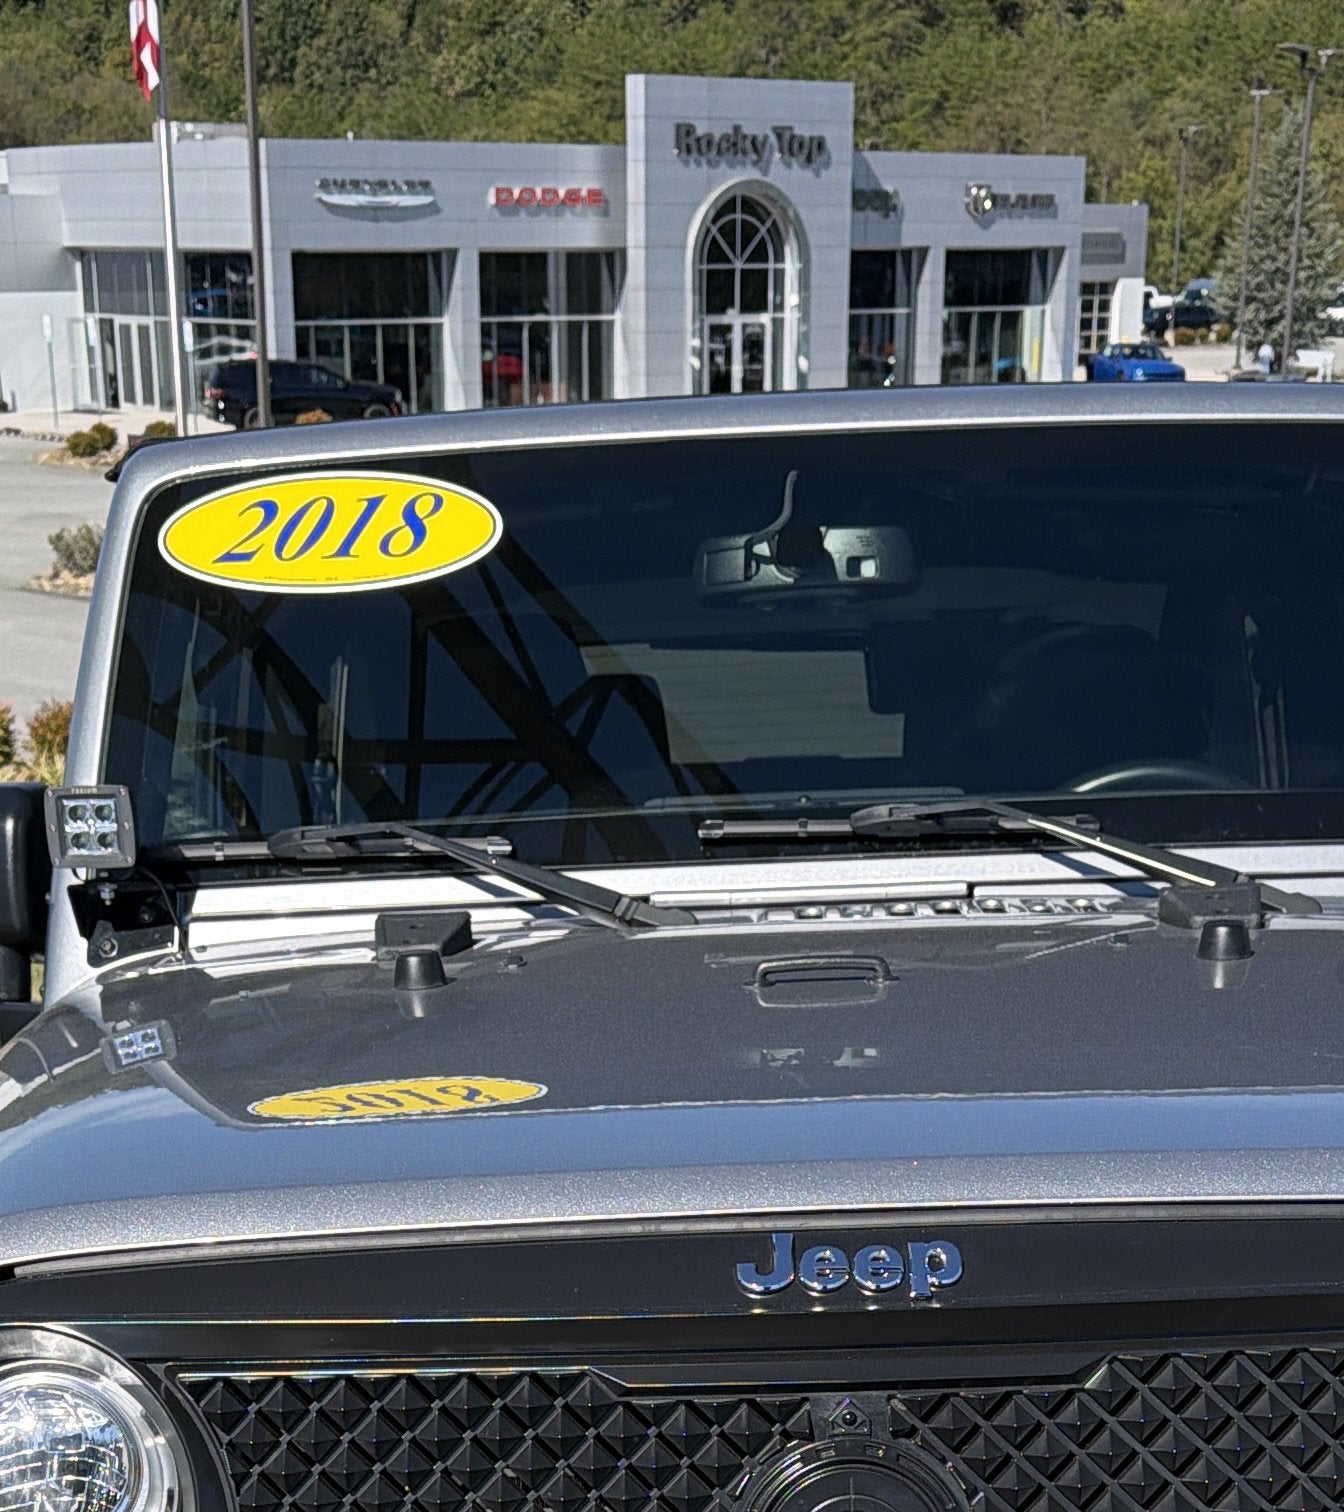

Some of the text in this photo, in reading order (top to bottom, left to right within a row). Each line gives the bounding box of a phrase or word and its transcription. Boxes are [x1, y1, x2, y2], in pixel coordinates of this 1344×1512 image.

[675, 122, 827, 165] Rocky Top
[494, 186, 604, 207] DODGE
[212, 492, 444, 564] 2018
[736, 1232, 963, 1298] Jeep
